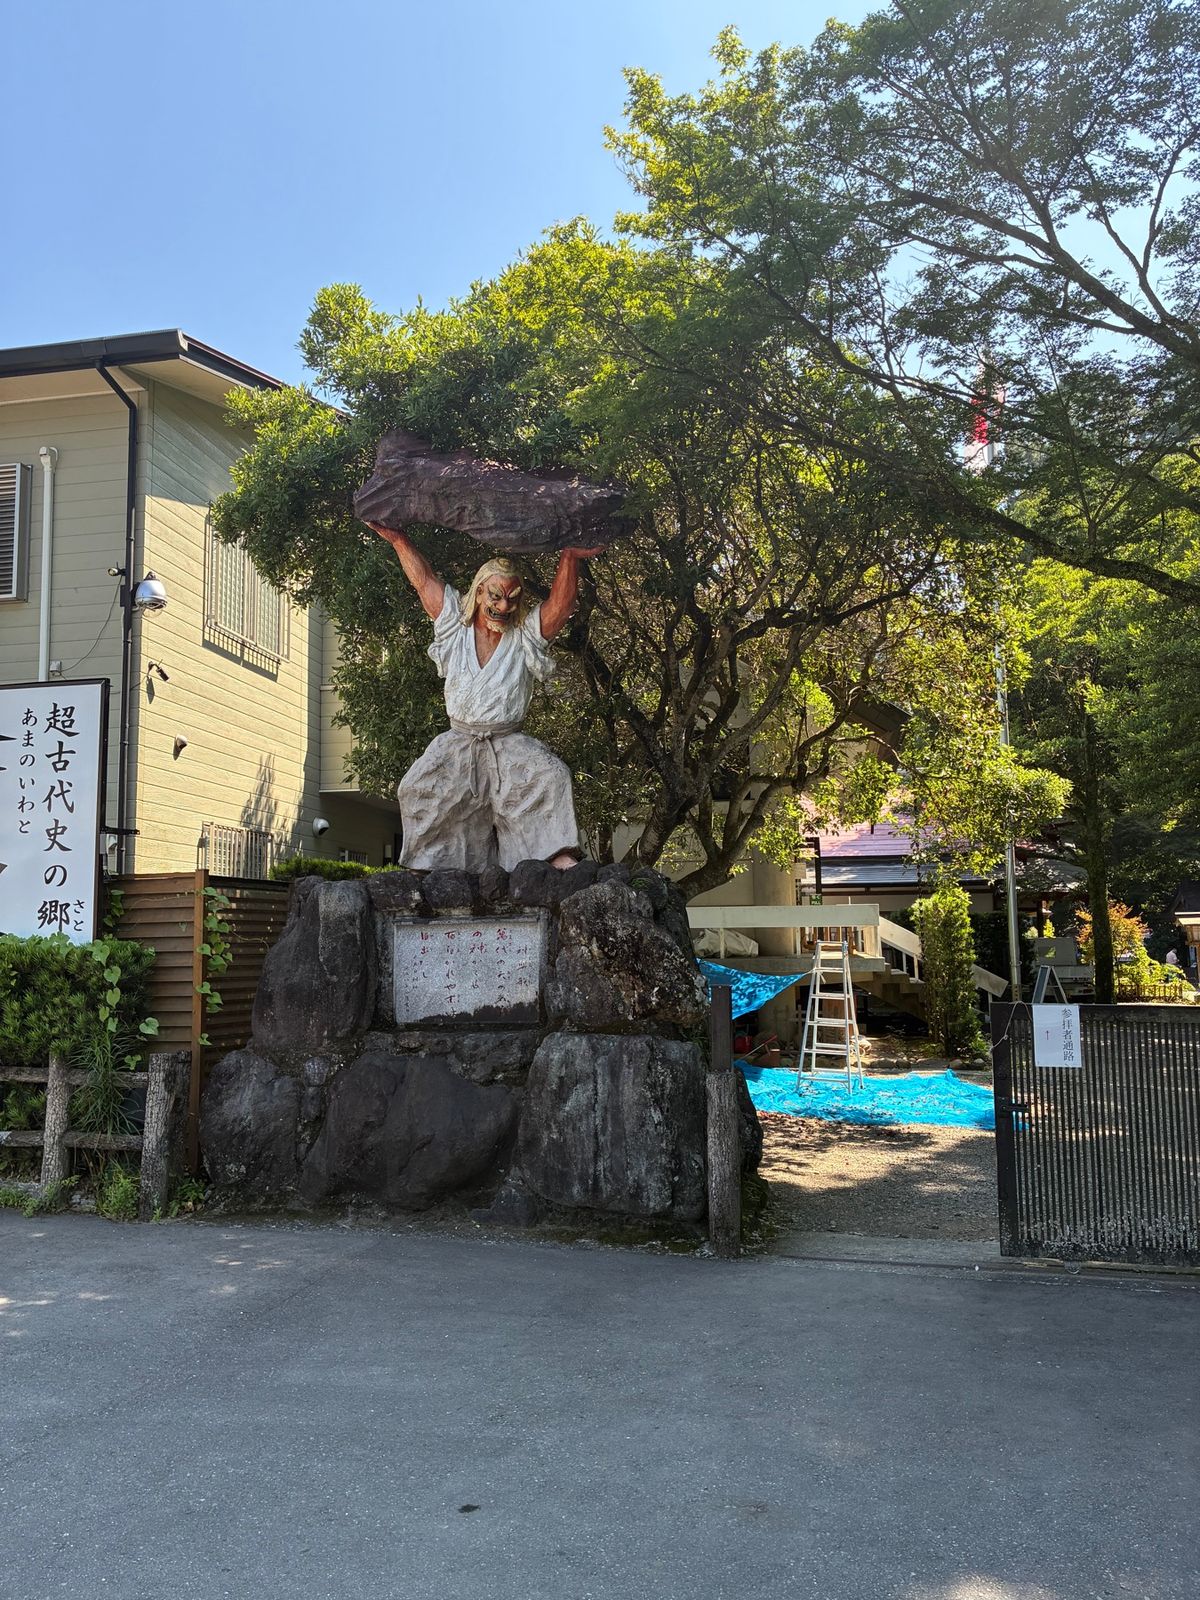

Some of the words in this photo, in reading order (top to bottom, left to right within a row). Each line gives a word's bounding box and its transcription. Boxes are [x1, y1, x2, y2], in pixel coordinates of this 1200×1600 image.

[17, 708, 38, 834] あまのいわと
[37, 702, 80, 932] 超古代史の郷
[73, 899, 85, 932] さと
